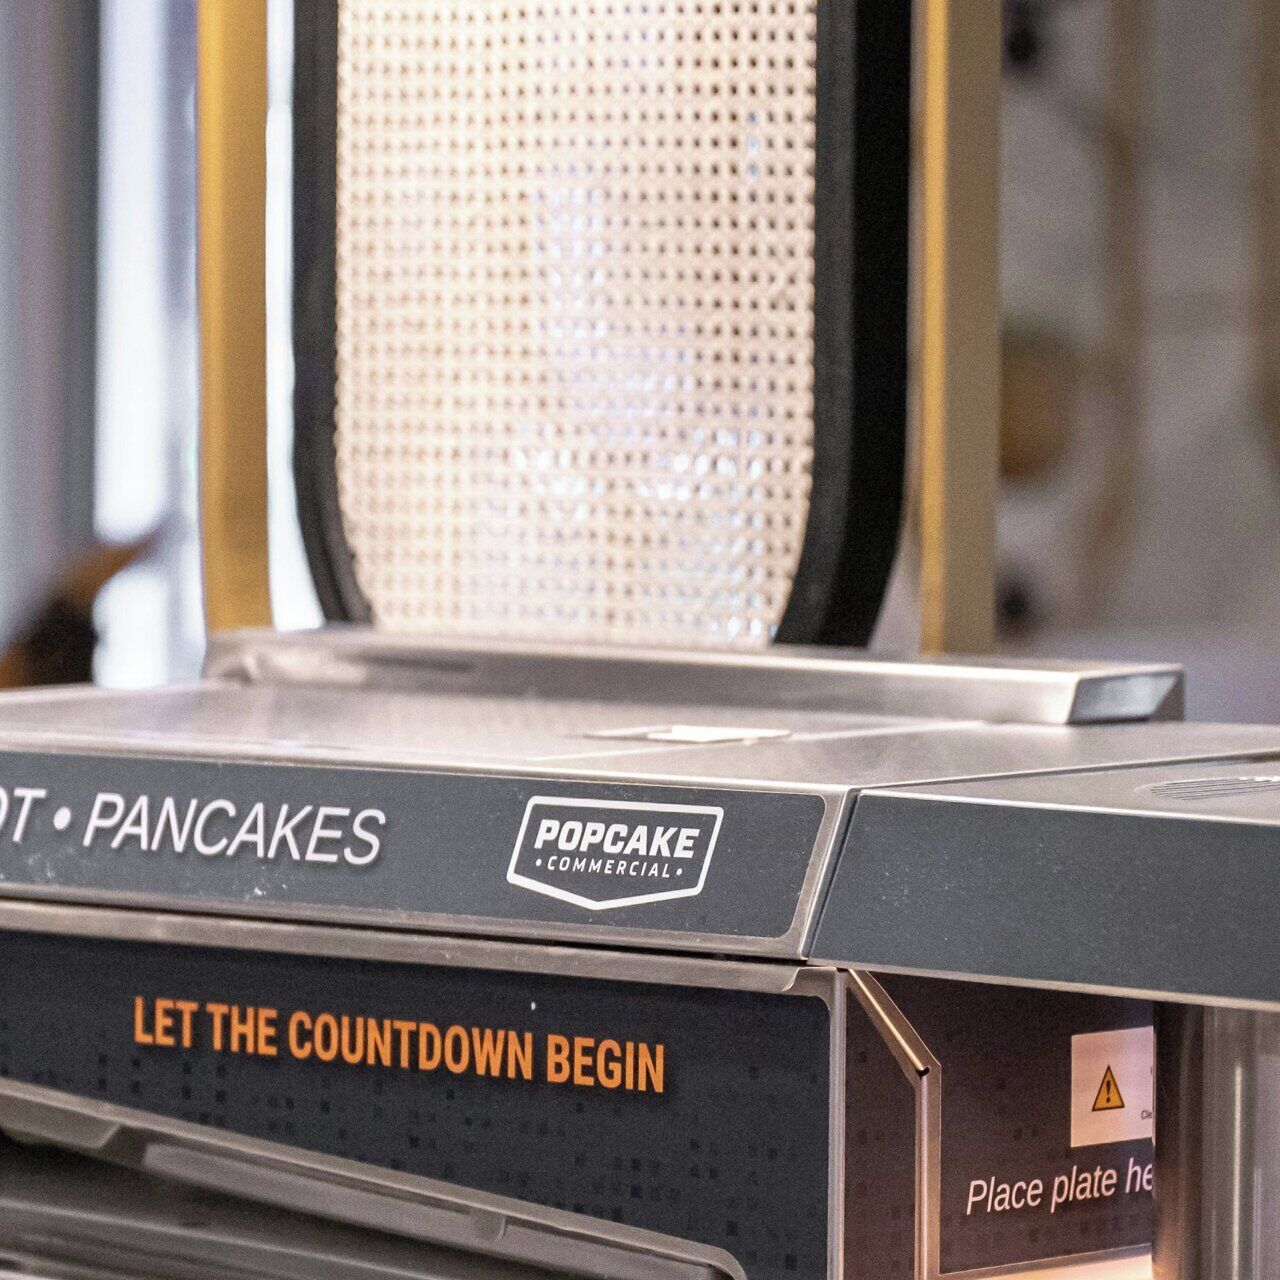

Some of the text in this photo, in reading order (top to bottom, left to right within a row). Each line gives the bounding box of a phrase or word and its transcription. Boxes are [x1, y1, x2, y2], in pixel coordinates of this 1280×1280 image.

[83, 792, 386, 865] PANCAKES
[533, 818, 700, 859] POPCAKE
[547, 855, 670, 878] COMMERCIAL
[134, 996, 664, 1092] LET THE COUNTDOWN BEGIN
[966, 1176, 1043, 1215] Place
[1050, 1165, 1118, 1213] plate
